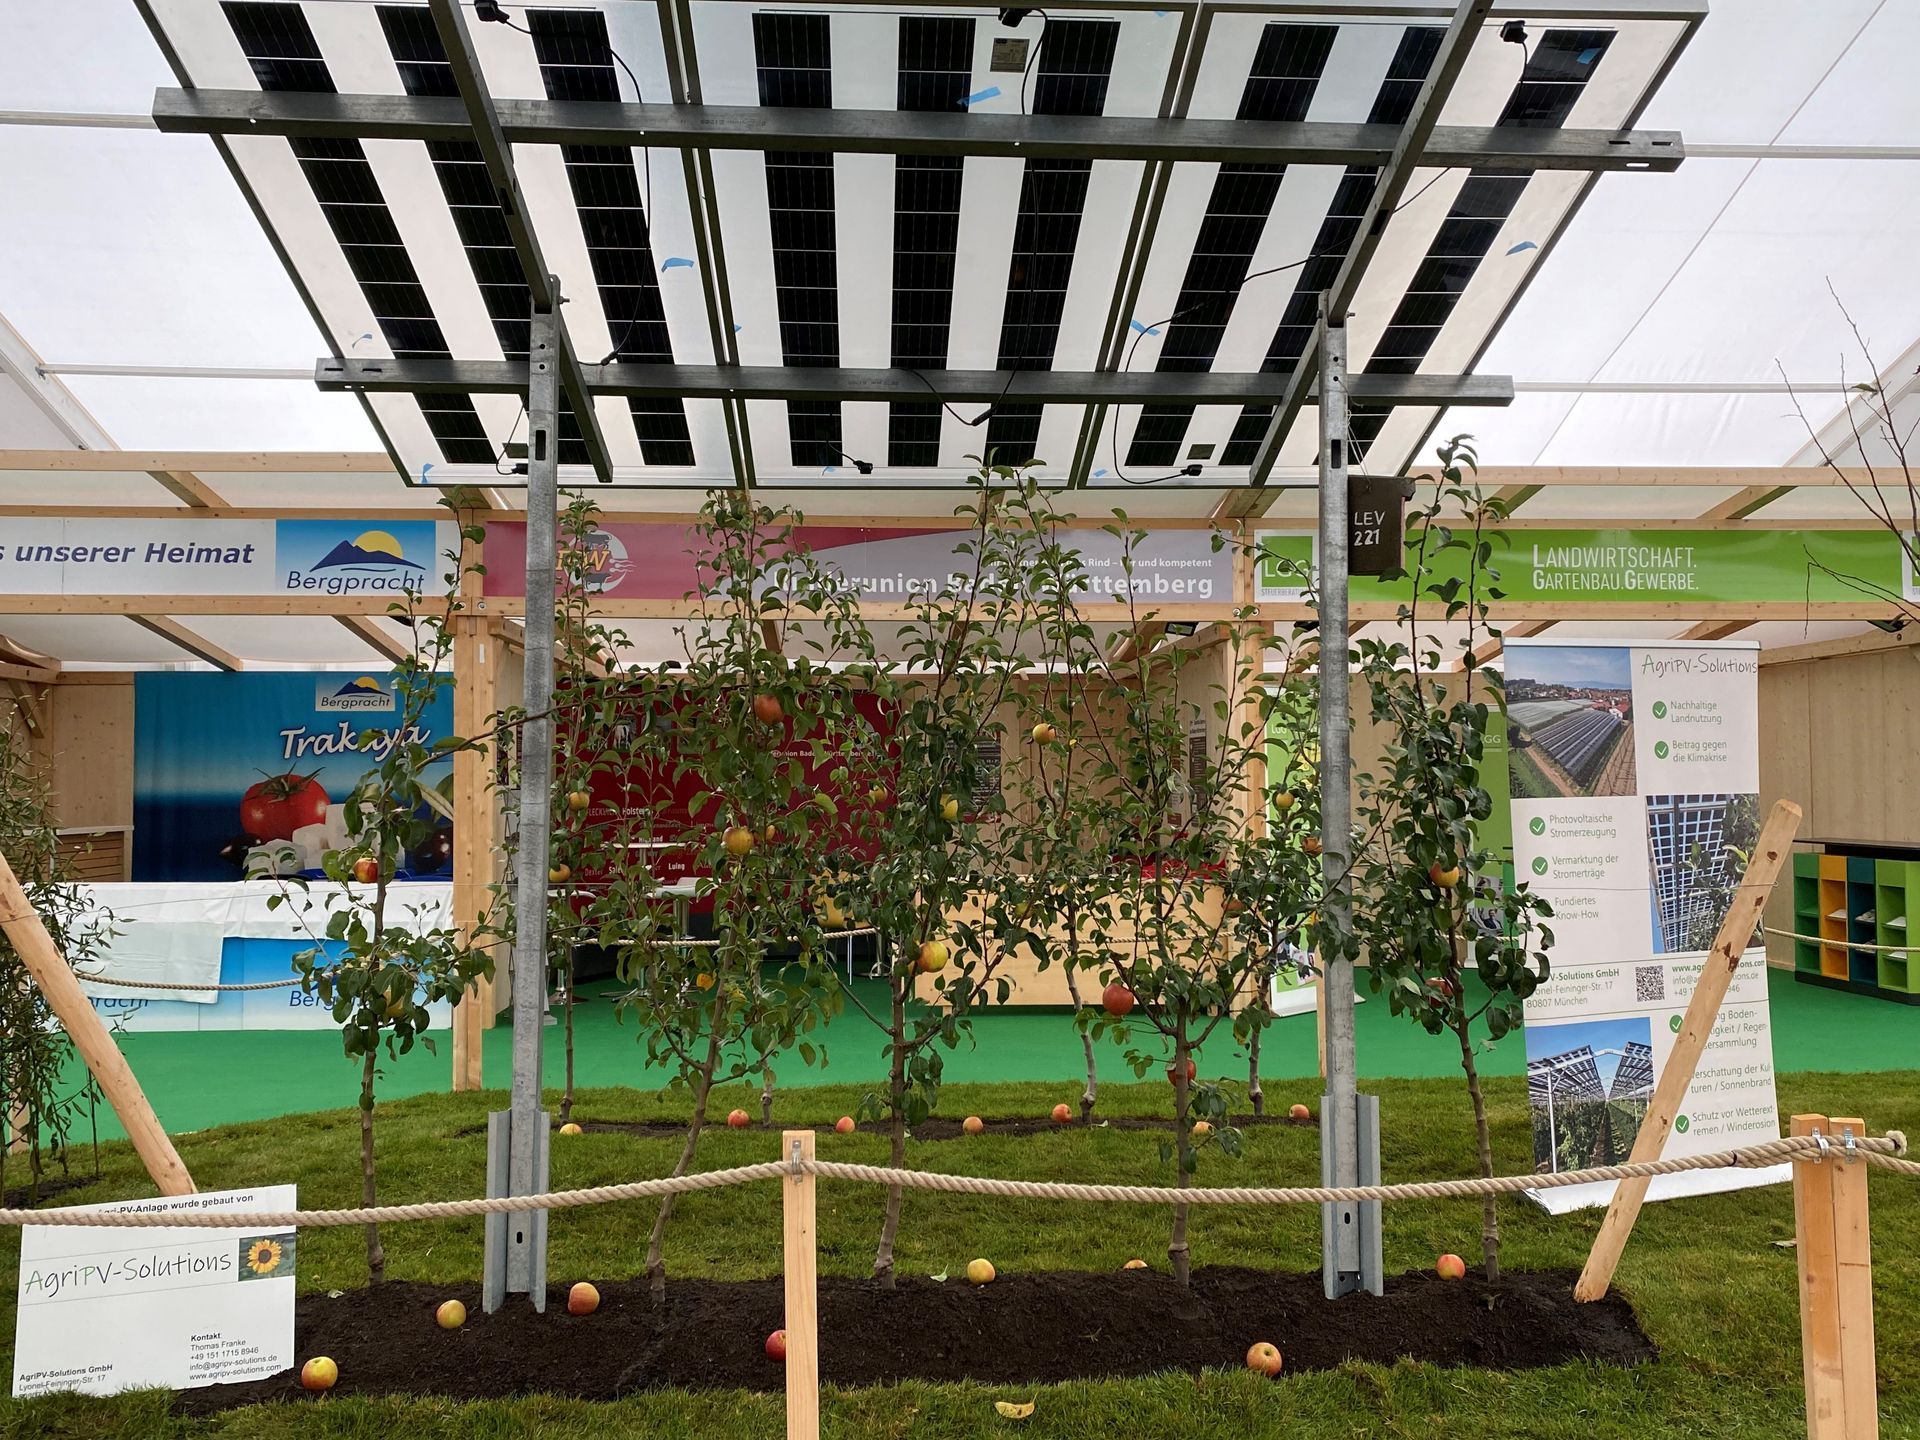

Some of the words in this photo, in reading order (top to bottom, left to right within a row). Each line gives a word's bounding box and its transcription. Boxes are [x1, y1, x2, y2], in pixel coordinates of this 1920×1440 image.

[1354, 511, 1385, 526] LEV
[1354, 530, 1380, 546] 221
[15, 546, 135, 562] unserer
[144, 543, 255, 563] Heimat
[1533, 544, 1697, 568] LANDWIRTSCHAFT.
[1088, 558, 1110, 567] Rind
[1138, 558, 1157, 568] und
[1159, 558, 1212, 569] kompetent
[287, 571, 425, 595] Bergpracht
[1641, 653, 1758, 678] AgriPV-Solutions
[320, 697, 390, 709] Bergpracht
[1670, 700, 1717, 711] Nachhaltige
[1671, 714, 1722, 725] Landnutzung
[1483, 734, 1501, 744] GG
[1672, 740, 1700, 750] Beitrag
[1702, 741, 1727, 751] gegen
[1673, 753, 1685, 762] die
[1687, 752, 1727, 762] Klimakrise
[1549, 813, 1613, 824] Photovoltaische
[1550, 828, 1617, 839] Stromerzeugung
[1552, 856, 1603, 867] Vermarktung
[1605, 854, 1619, 863] der
[668, 863, 686, 871] Luing
[1553, 869, 1605, 880] Stromerträge
[1555, 896, 1597, 906] Fundiertes
[1556, 911, 1599, 920] Know-How
[1549, 970, 1594, 981] V-Solutions
[1596, 968, 1620, 978] GmbH
[1535, 982, 1603, 996] onel-Feininger-Str.
[1605, 981, 1614, 990] 17
[1526, 999, 1552, 1008] 80807
[1554, 997, 1588, 1006] München
[1728, 1010, 1757, 1019] Boden-
[1744, 1064, 1758, 1074] der
[1691, 1084, 1712, 1094] turen
[1720, 1078, 1772, 1091] Sonnenbrand
[1692, 1111, 1719, 1122] Schutz
[1721, 1110, 1734, 1119] vor
[1693, 1125, 1719, 1136] remen
[1726, 1119, 1776, 1132] Winderosion
[171, 1199, 199, 1210] wurde
[201, 1197, 234, 1208] gebaut
[236, 1194, 254, 1203] von
[25, 1252, 232, 1298] AgriPV-Solutions
[190, 1342, 219, 1351] Thomas
[221, 1340, 246, 1348] Franke
[207, 1351, 219, 1359] 151
[241, 1347, 259, 1355] 8946
[190, 1354, 278, 1371] info@agripv-solutions.de
[20, 1366, 87, 1382] AgriPV-Solutions
[88, 1364, 113, 1373] GmbH
[190, 1364, 281, 1380] www.agripv-solutions.com
[97, 1374, 106, 1383] 17
